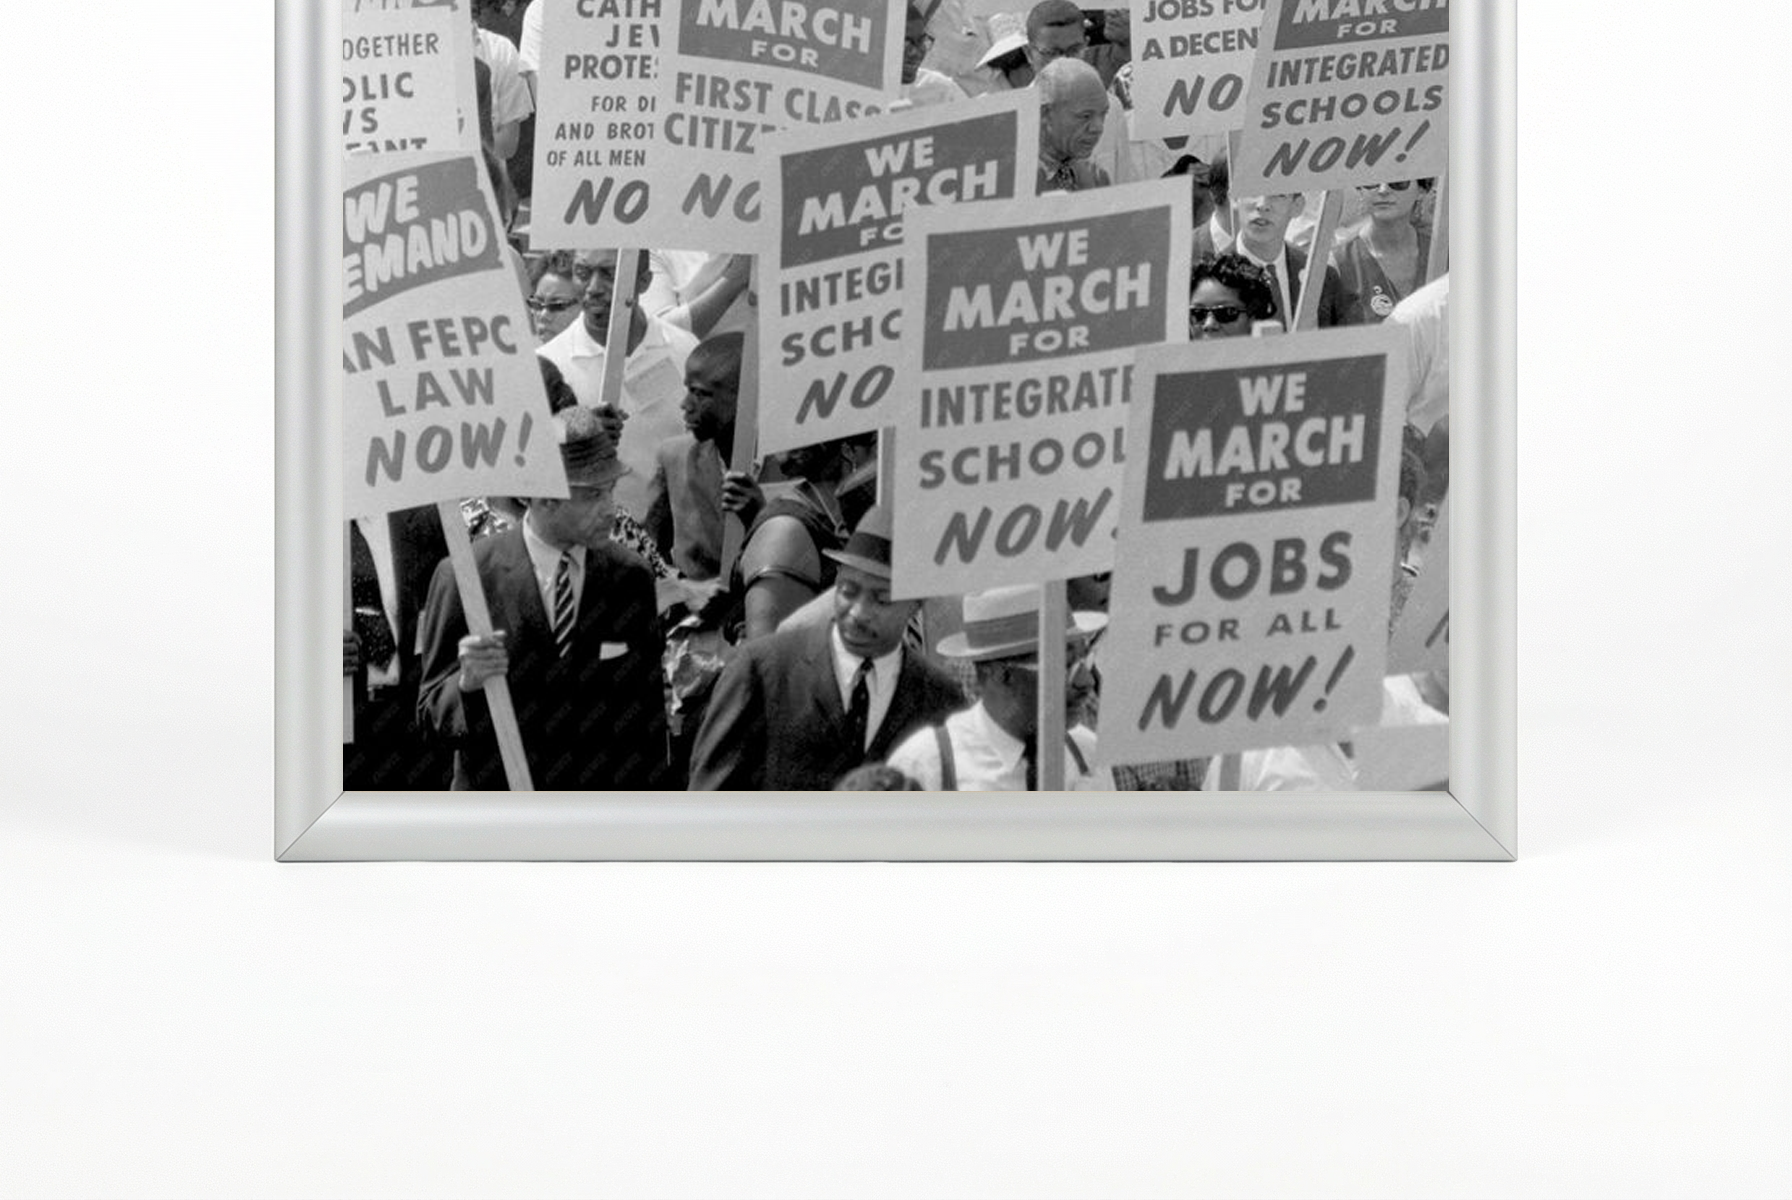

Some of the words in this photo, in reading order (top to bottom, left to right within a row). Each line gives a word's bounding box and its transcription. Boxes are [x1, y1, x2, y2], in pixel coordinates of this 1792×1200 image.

[1141, 38, 1166, 61] A
[1169, 26, 1262, 58] DECEN
[1337, 19, 1398, 39] FOR
[750, 40, 820, 68] FOR
[1266, 43, 1449, 89] INTEGRATED
[591, 96, 627, 112] FOR
[675, 71, 773, 114] FIRST
[1260, 85, 1444, 129] SCHOOLS
[555, 122, 594, 141] AND
[1262, 119, 1431, 179] NOW!
[547, 150, 568, 166] OF
[573, 150, 602, 166] ALL
[609, 149, 646, 166] MEN
[864, 136, 934, 177] WE
[345, 175, 420, 243] WE
[799, 160, 998, 236] MARCH
[1017, 229, 1090, 271] WE
[943, 262, 1152, 332] MARCH
[407, 314, 518, 361] FEPC
[1010, 325, 1090, 355] FOR
[377, 367, 495, 418] LAW
[1239, 373, 1307, 417] WE
[365, 410, 534, 488] NOW!
[1163, 413, 1366, 480] MARCH
[1225, 478, 1303, 507] FOR
[1152, 530, 1353, 607] JOBS
[1155, 618, 1241, 647] FOR
[1266, 607, 1342, 637] ALL
[1138, 644, 1356, 732] NOW!
